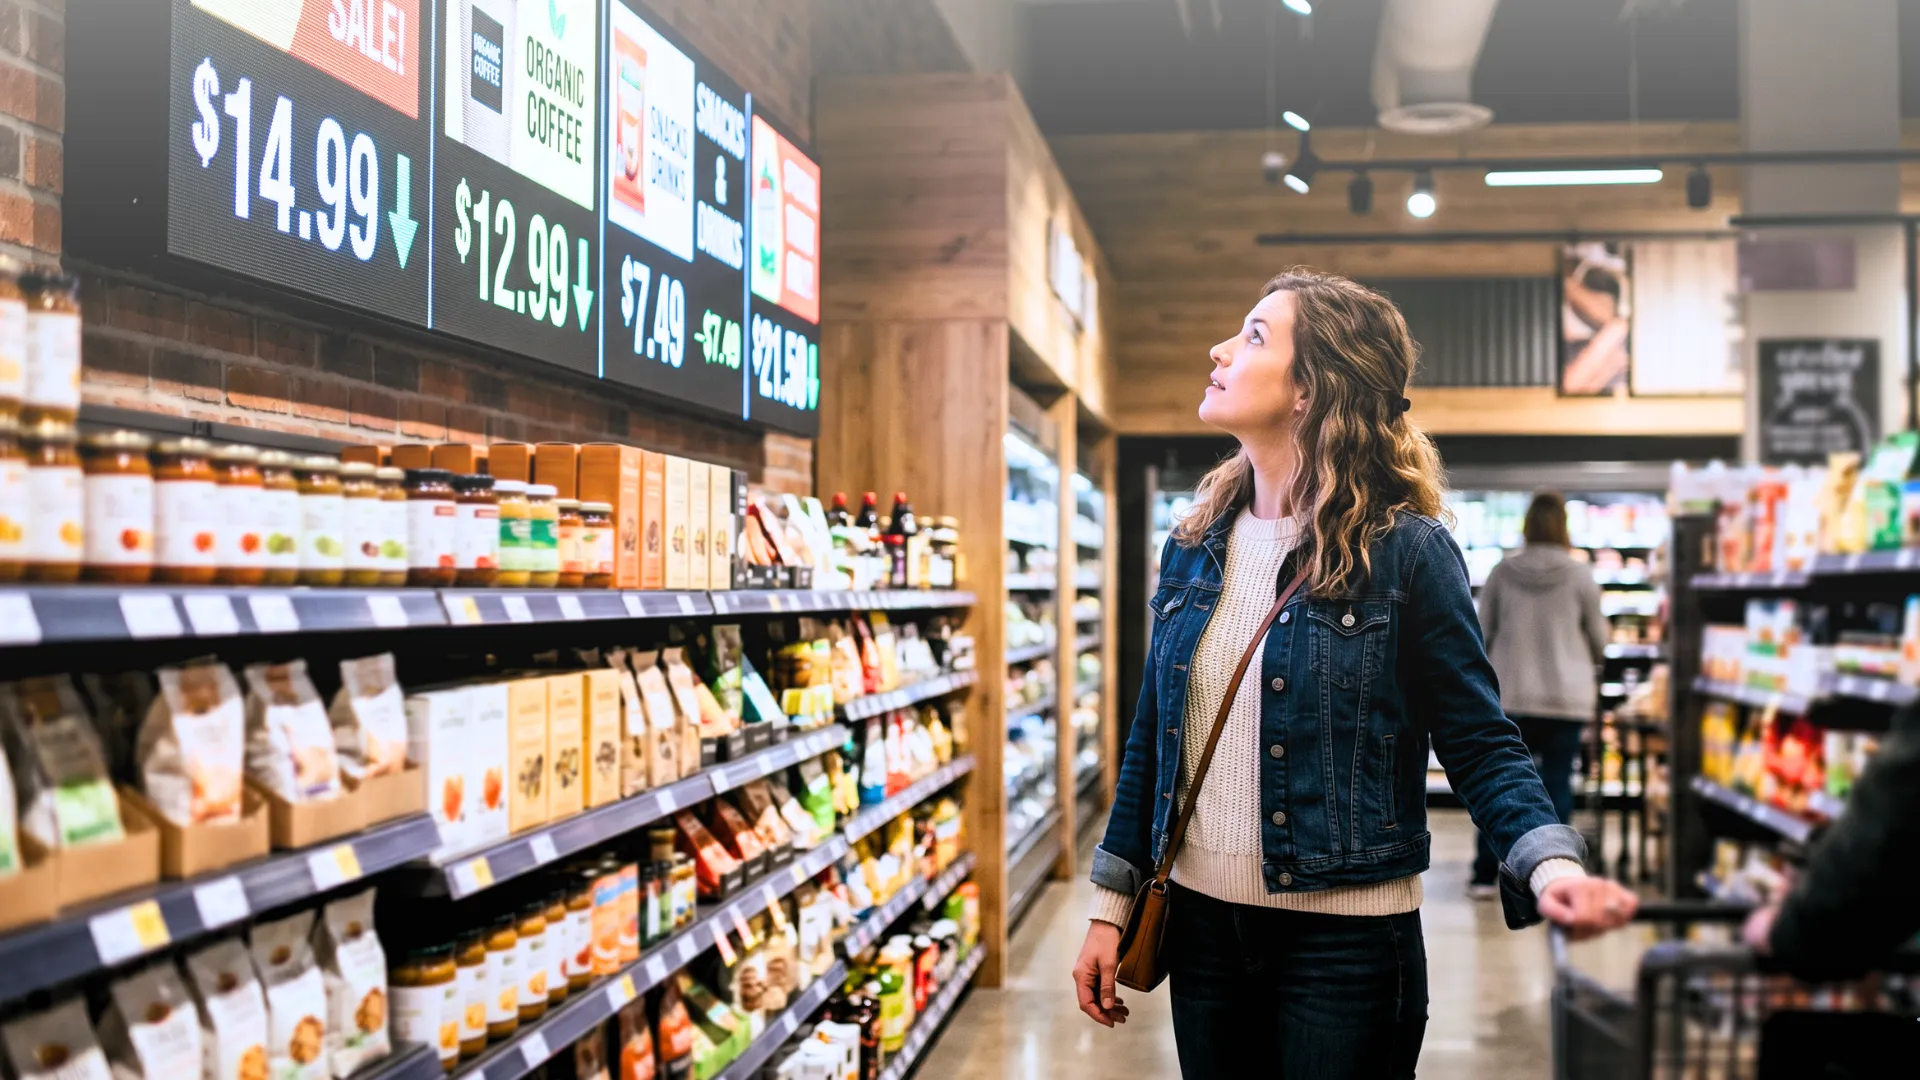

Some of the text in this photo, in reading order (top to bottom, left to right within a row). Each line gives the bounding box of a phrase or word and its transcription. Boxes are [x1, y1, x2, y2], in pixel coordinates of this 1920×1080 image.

[474, 54, 500, 87] COFFEE
[526, 35, 584, 108] ORGANIC
[192, 57, 379, 261] $14.99
[527, 90, 582, 164] COFFEE
[455, 177, 568, 328] $12.99
[621, 254, 685, 369] $7.49
